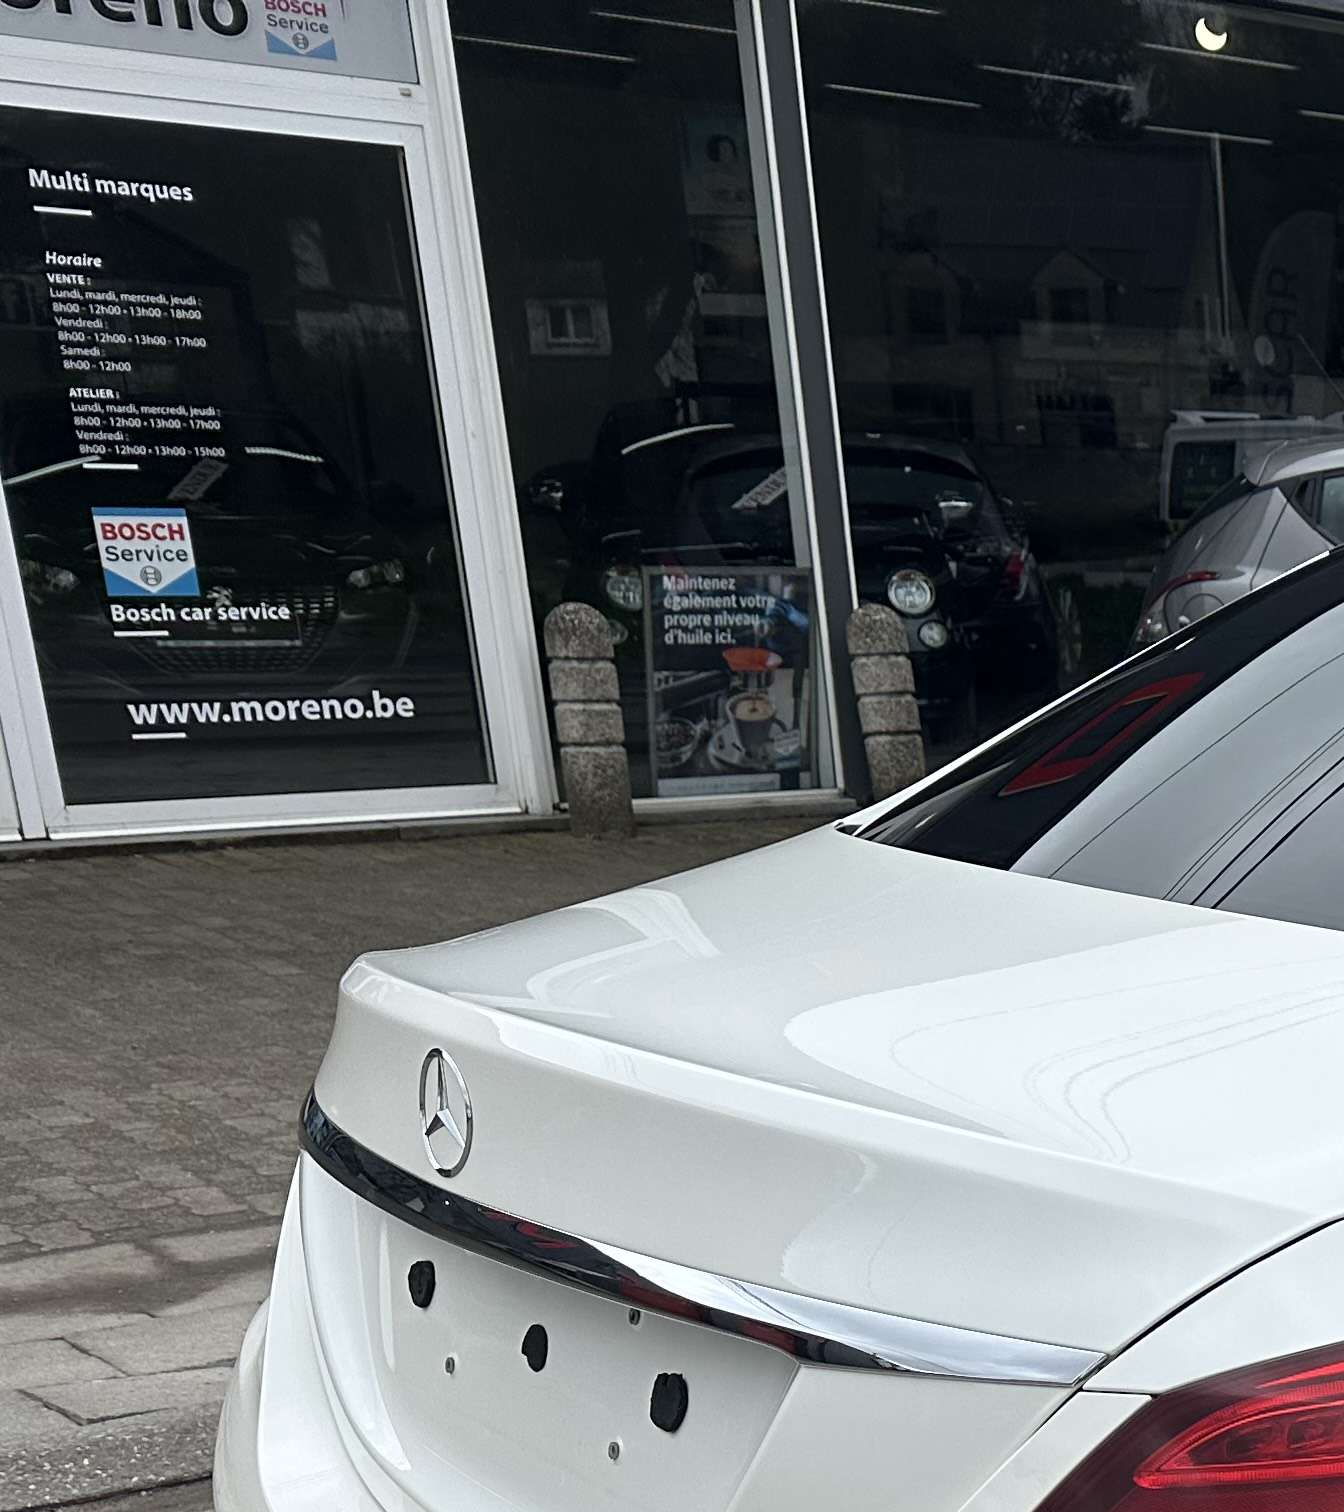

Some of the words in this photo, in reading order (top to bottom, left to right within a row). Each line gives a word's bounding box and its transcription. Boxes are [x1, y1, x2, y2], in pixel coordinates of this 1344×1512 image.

[264, 0, 327, 17] BOSCH
[266, 13, 330, 35] Service
[28, 168, 90, 192] Multi
[95, 178, 194, 203] marques
[45, 251, 103, 268] Horaire
[46, 272, 85, 286] VENTE
[50, 287, 83, 300] Lundi,
[85, 290, 119, 303] mardi,
[120, 293, 169, 306] mercredi,
[52, 302, 80, 314] 8h00
[89, 303, 122, 316] 12h00
[57, 330, 85, 342] 8h00
[94, 332, 127, 345] 12h00
[174, 336, 207, 348] 17h00
[63, 359, 91, 371] 8h00
[99, 361, 132, 372] 12h00
[69, 387, 115, 400] ATELIER
[71, 402, 105, 414] Lundi,
[106, 403, 140, 415] mardi,
[141, 405, 189, 417] mercredi,
[73, 416, 101, 427] 8h00
[110, 417, 142, 429] 12h00
[150, 418, 182, 430] 13h00
[189, 419, 221, 431] 17h00
[79, 444, 106, 455] 8h00
[114, 445, 146, 456] 12h00
[154, 446, 186, 457] 13h00
[100, 522, 186, 541] BOSCH
[105, 545, 188, 562] Service
[662, 575, 736, 591] Maintenez
[739, 594, 776, 608] votre
[110, 602, 176, 622] Bosch
[180, 606, 212, 621] car
[218, 602, 290, 621] service
[664, 612, 711, 629] propre
[714, 611, 760, 627] niveau
[664, 629, 713, 645] d'huile
[715, 629, 736, 645] ici.
[127, 690, 415, 725] www.moreno.be
